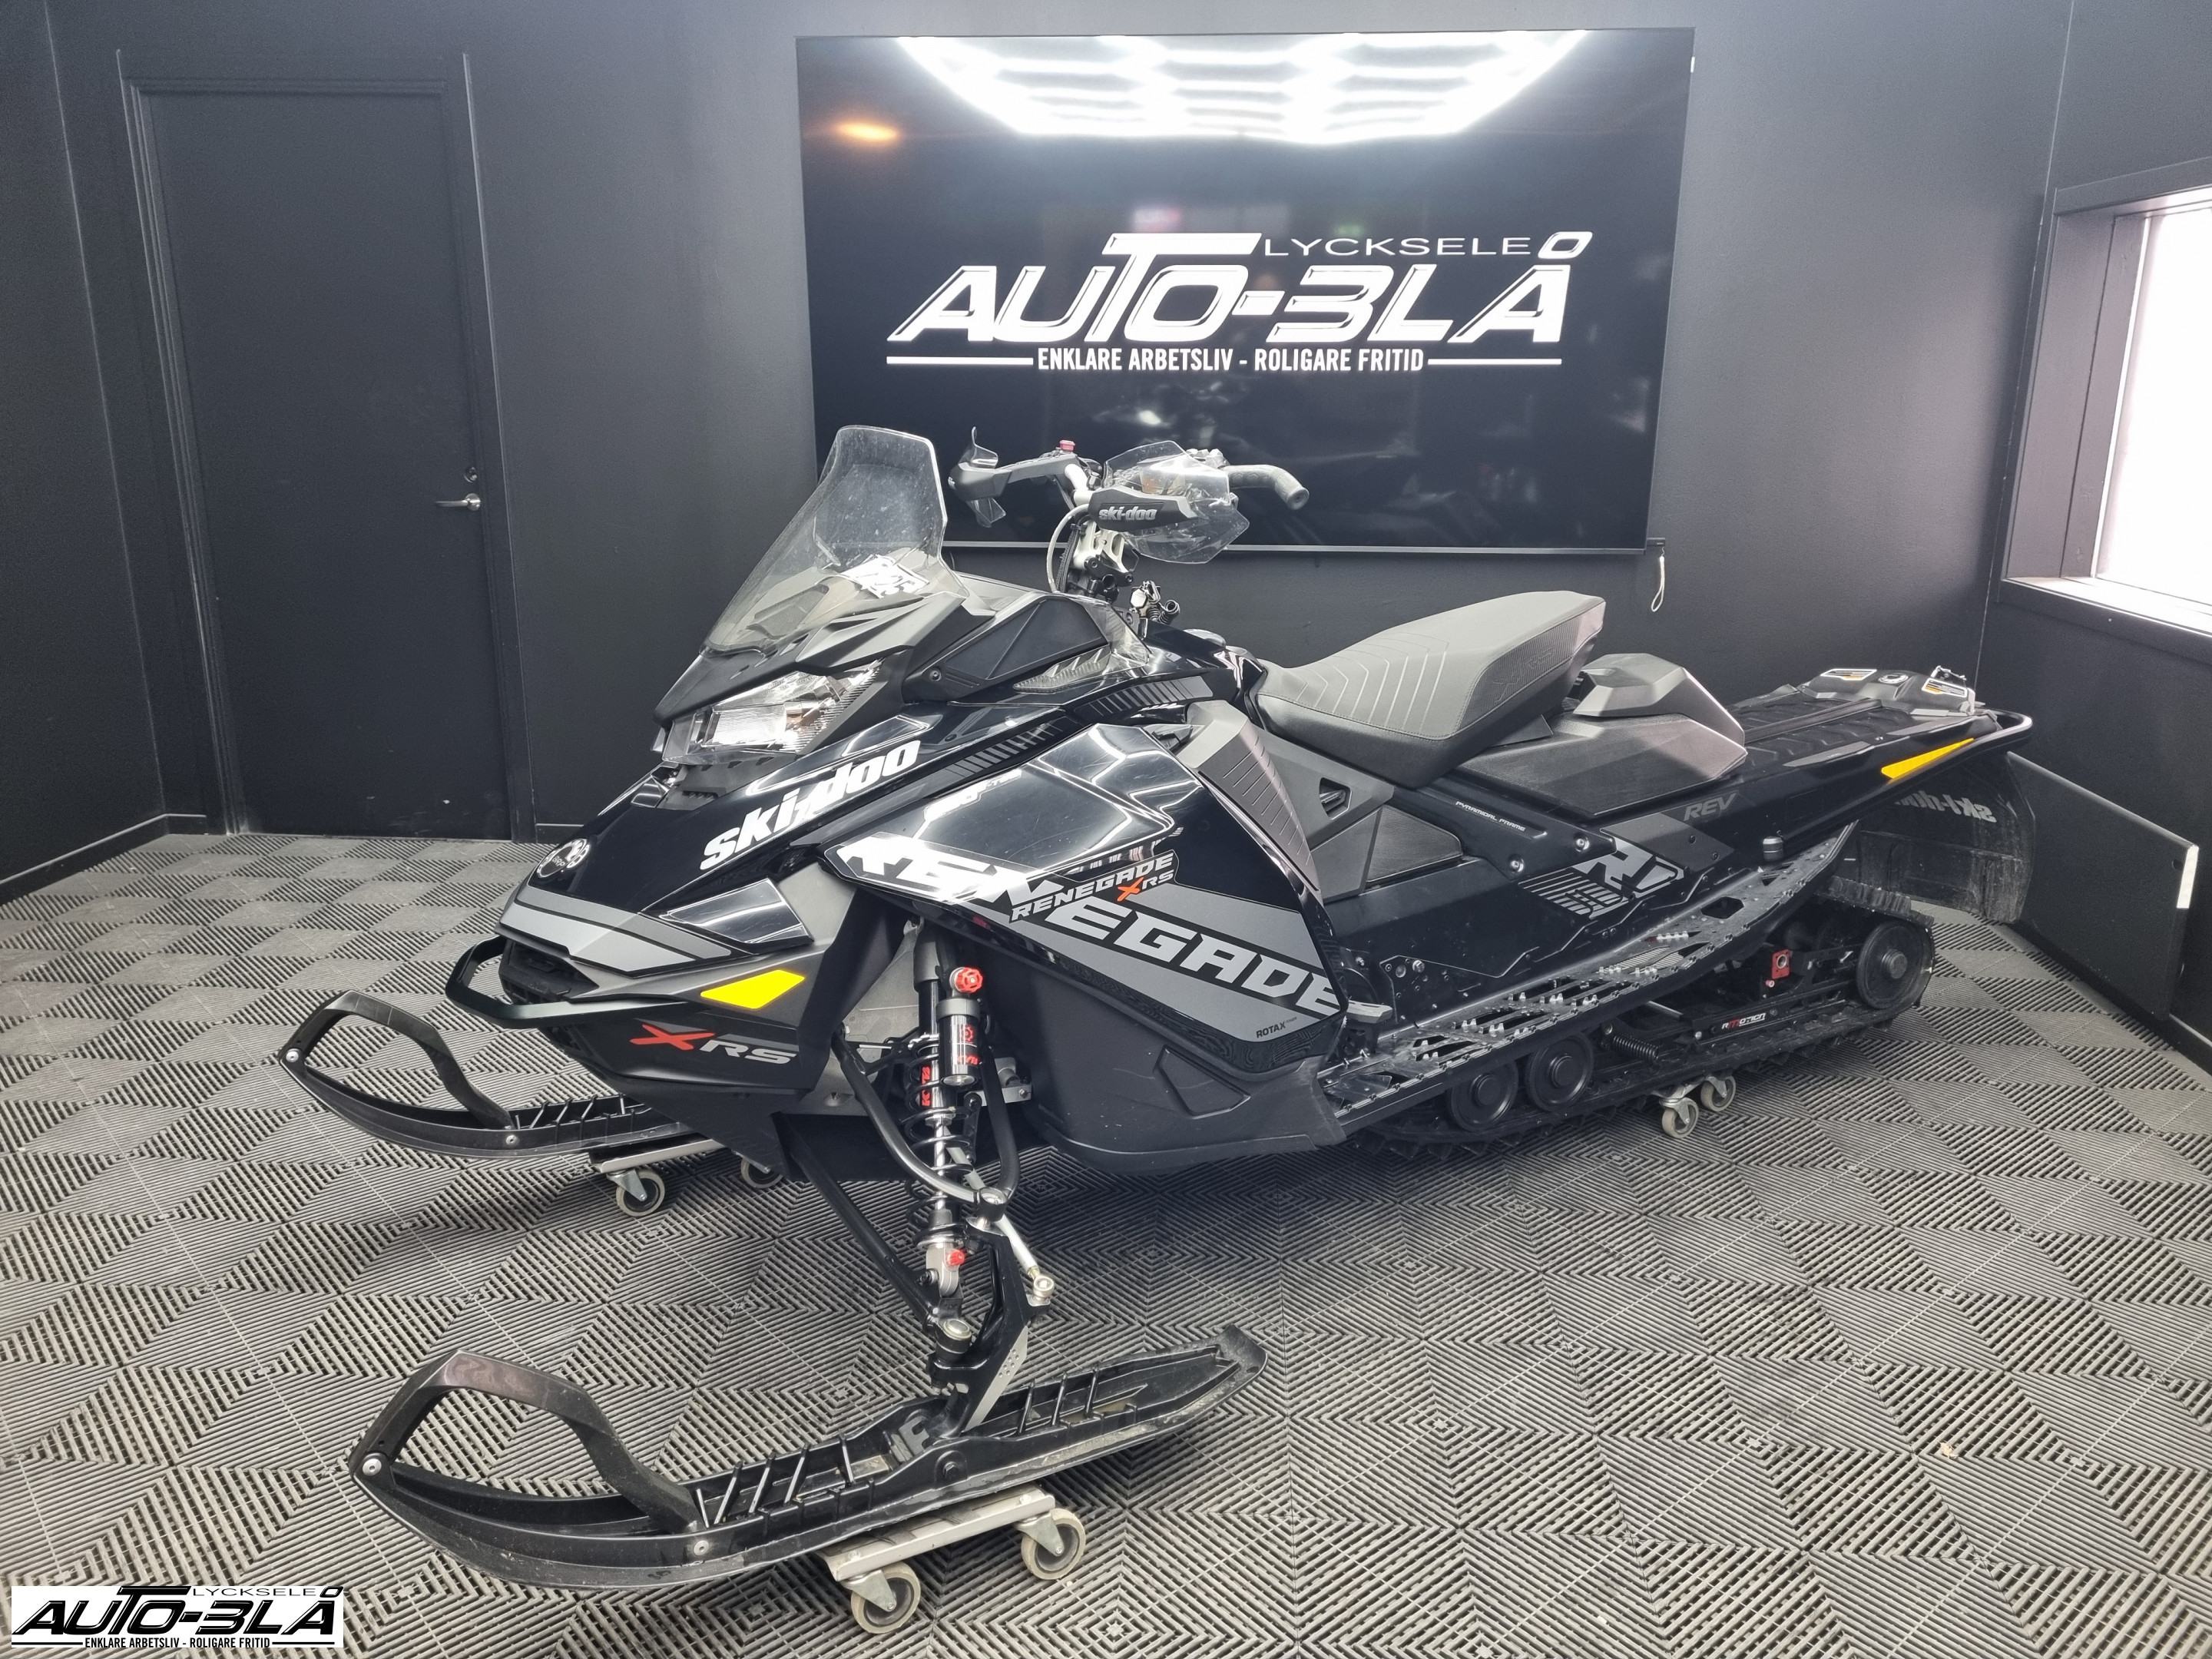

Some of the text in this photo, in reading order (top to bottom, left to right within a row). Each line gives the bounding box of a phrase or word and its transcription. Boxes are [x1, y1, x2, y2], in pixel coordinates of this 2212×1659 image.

[1264, 237, 1531, 257] LYCKSELE
[1038, 347, 1121, 372] ENKLARE
[1128, 347, 1233, 372] ARBETSLIV
[1254, 347, 1351, 372] ROLIGARE
[1359, 347, 1425, 373] FRITID
[1098, 506, 1157, 522] ski-doo
[1455, 800, 1526, 832] PYRAMIDAL FRAME
[1683, 793, 1737, 822] REV
[1010, 852, 1174, 922] RENEGADE
[1116, 869, 1174, 902] XRS
[629, 1024, 798, 1065] XRS
[1256, 1022, 1286, 1038] ROTAX
